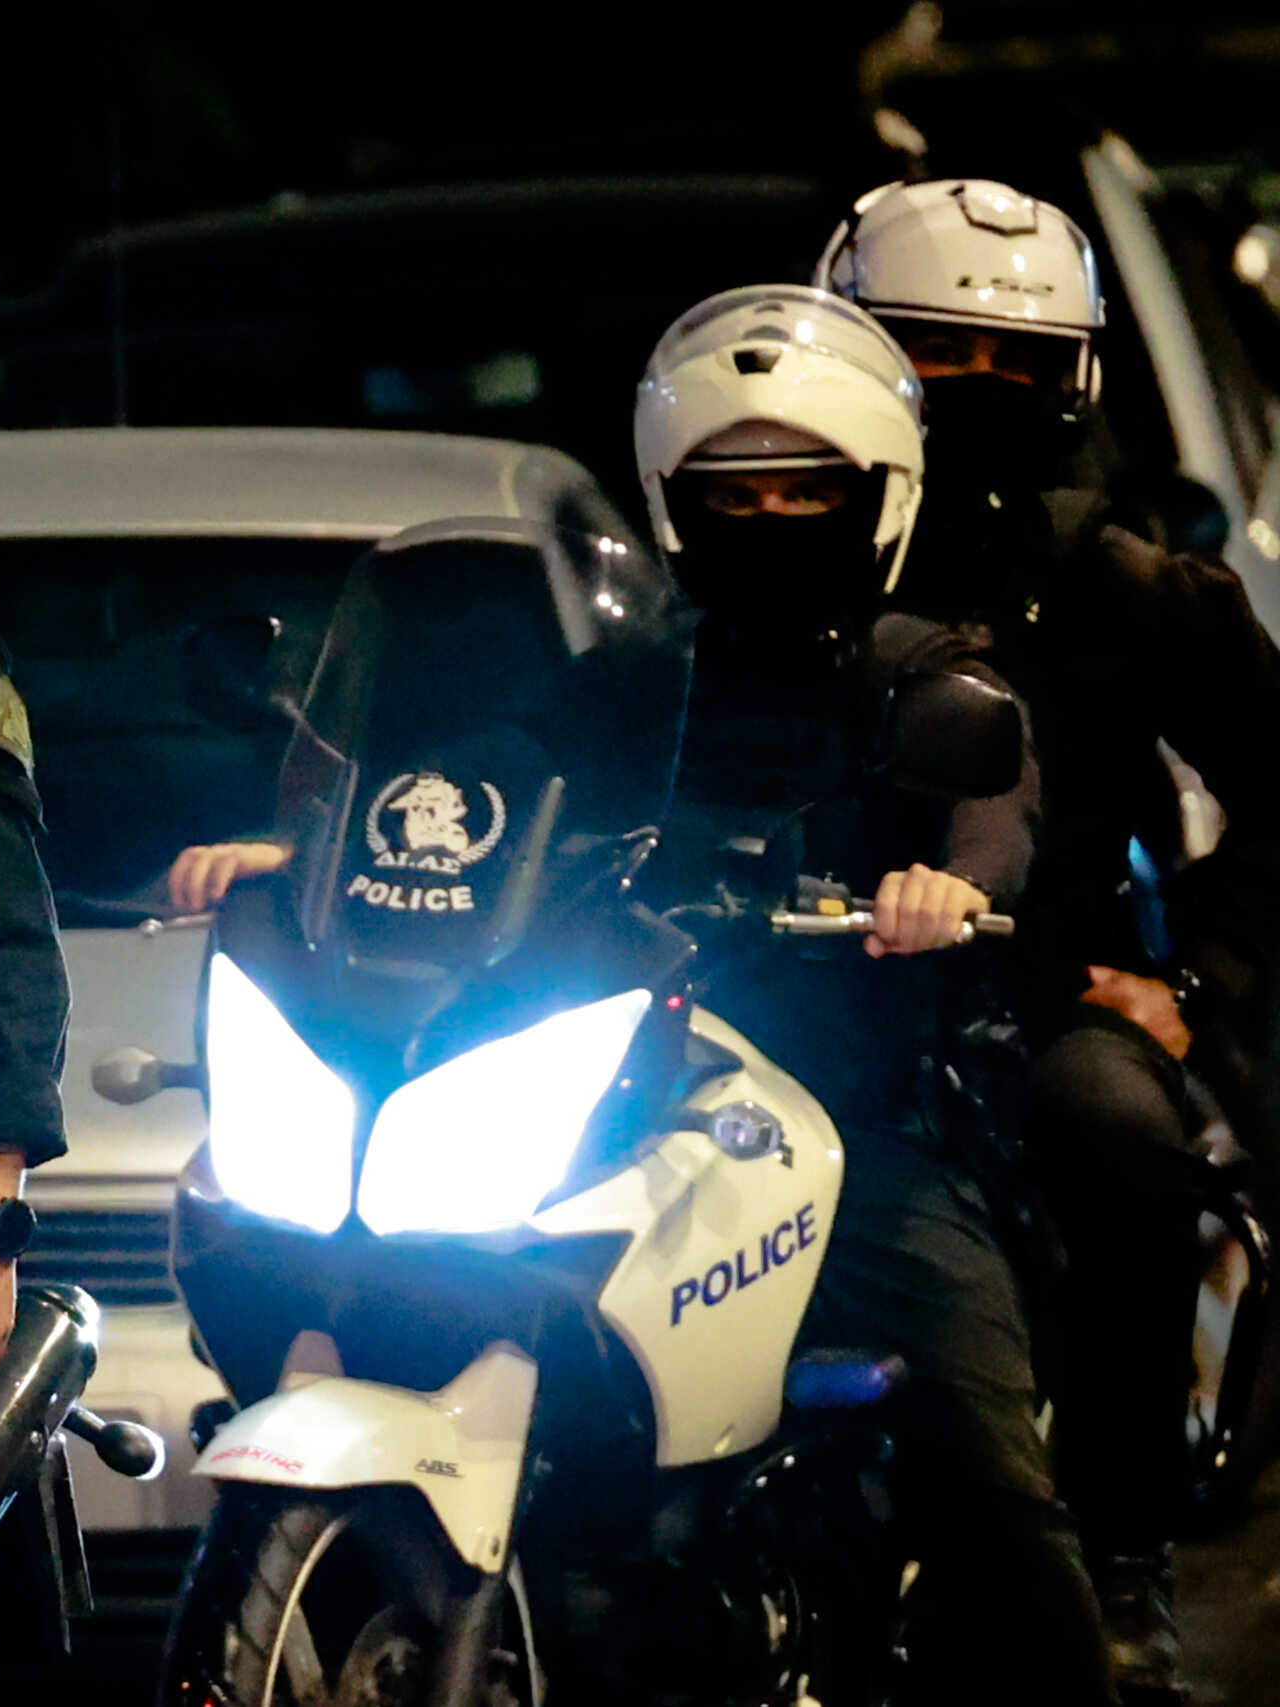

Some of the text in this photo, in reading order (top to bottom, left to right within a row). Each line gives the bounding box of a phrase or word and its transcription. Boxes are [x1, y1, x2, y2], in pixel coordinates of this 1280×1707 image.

[347, 874, 475, 911] POLICE
[671, 1201, 817, 1327] POLICE
[414, 1458, 459, 1475] ABS
